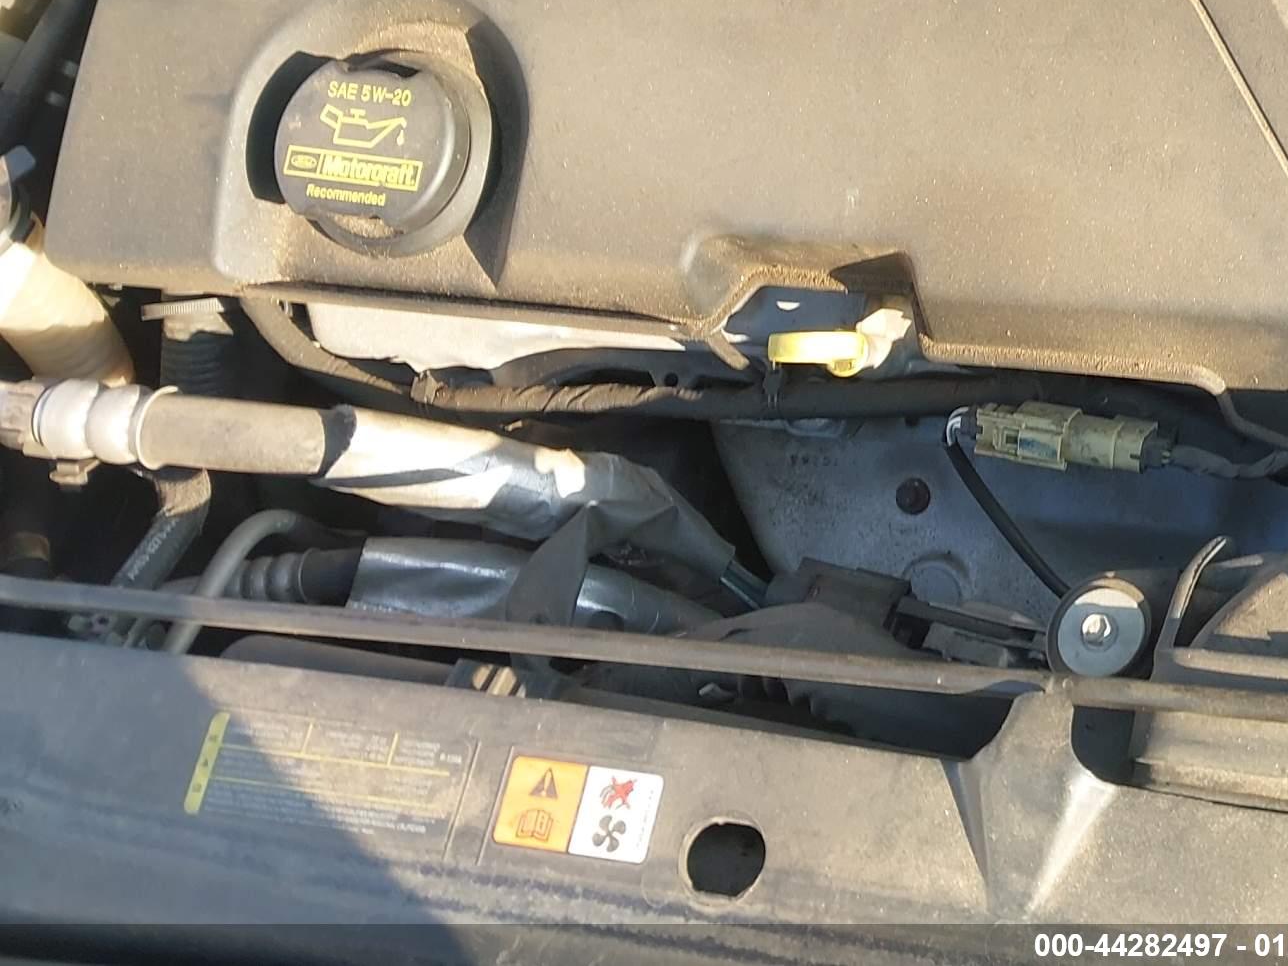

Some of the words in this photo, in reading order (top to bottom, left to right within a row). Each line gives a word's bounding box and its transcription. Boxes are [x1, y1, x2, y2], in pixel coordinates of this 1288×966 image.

[328, 81, 358, 100] SAE
[362, 85, 412, 107] 5W-20
[306, 184, 386, 206] Recommended
